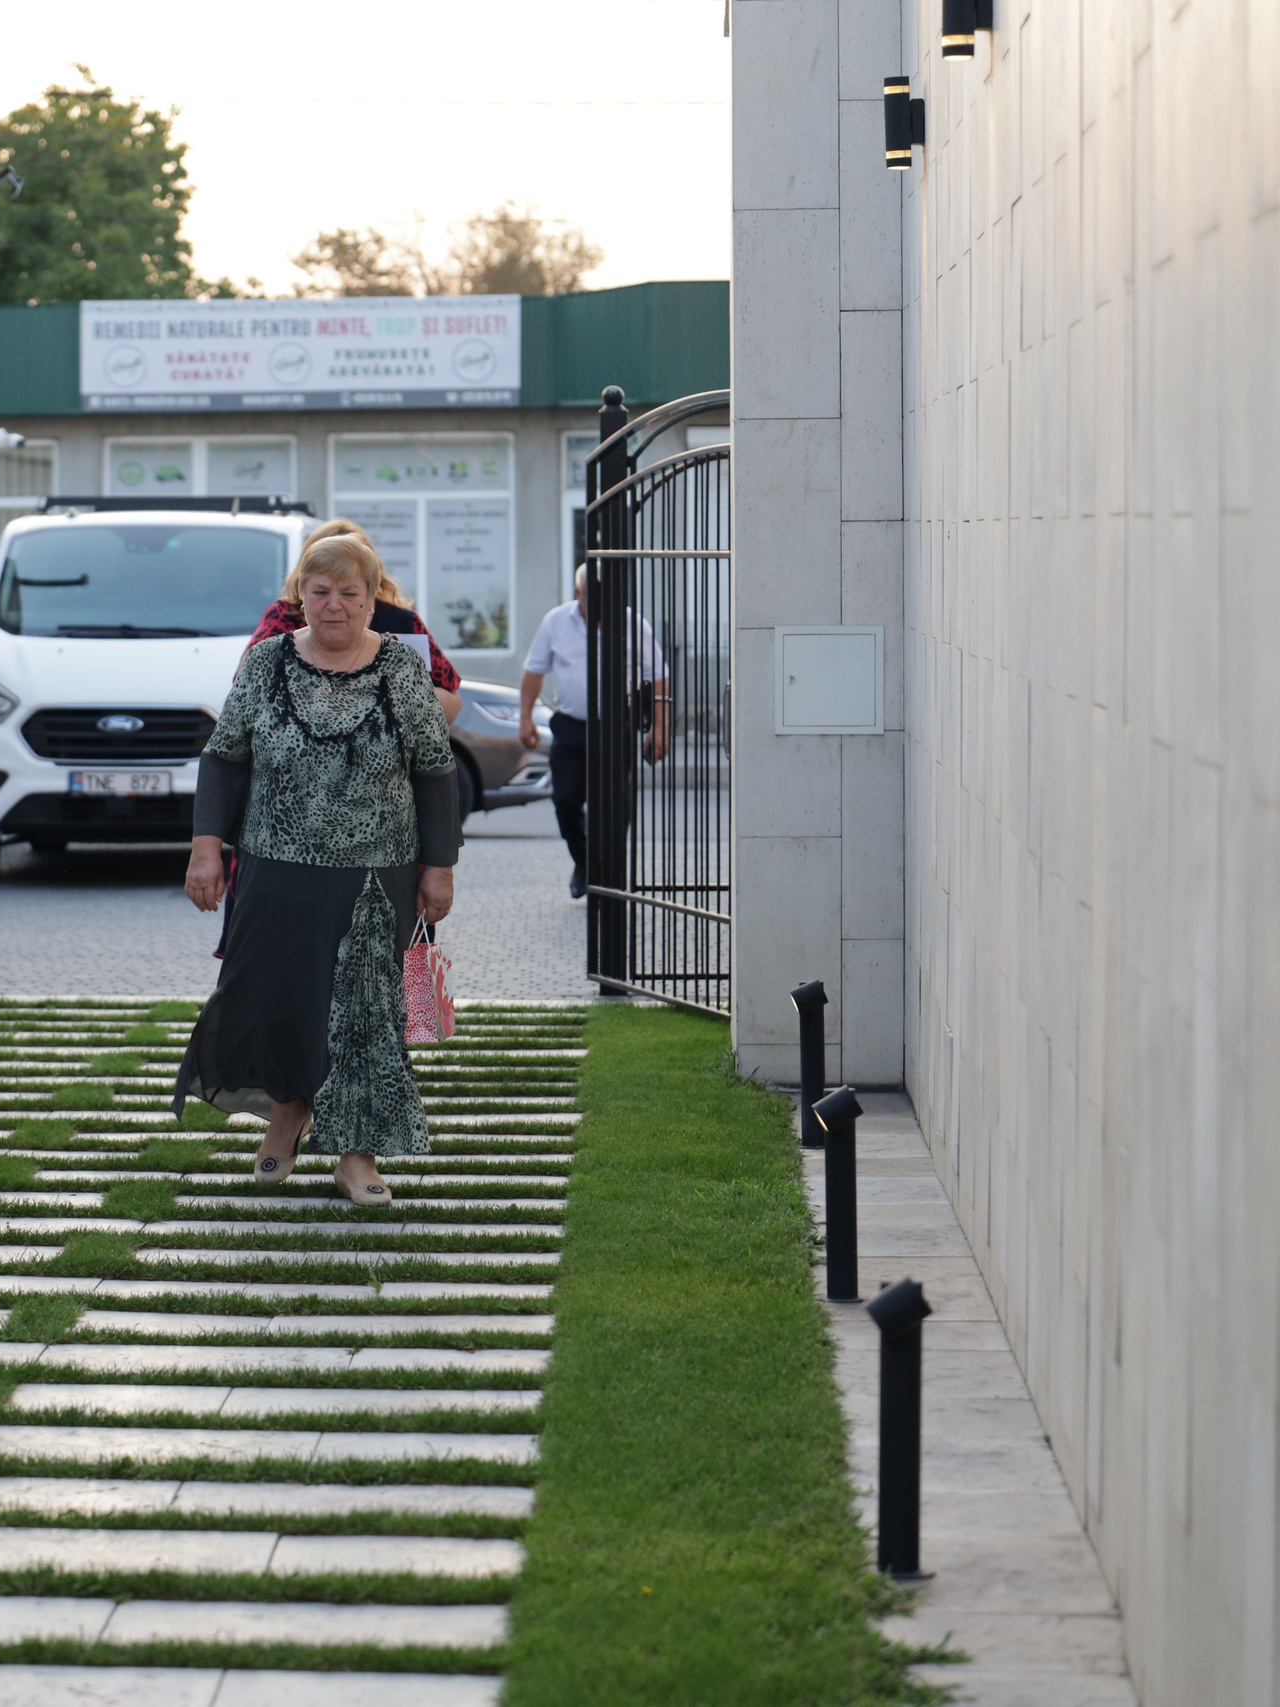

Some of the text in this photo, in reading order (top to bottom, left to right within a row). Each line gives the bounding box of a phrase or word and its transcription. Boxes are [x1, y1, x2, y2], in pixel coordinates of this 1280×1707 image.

[94, 321, 161, 339] REMEDII
[167, 319, 245, 338] NATURALE
[251, 318, 311, 337] PENTRU
[317, 317, 371, 338] MINTE,
[376, 316, 417, 335] TRUP
[444, 314, 508, 335] SUFLET!
[86, 774, 160, 790] TNE 872
